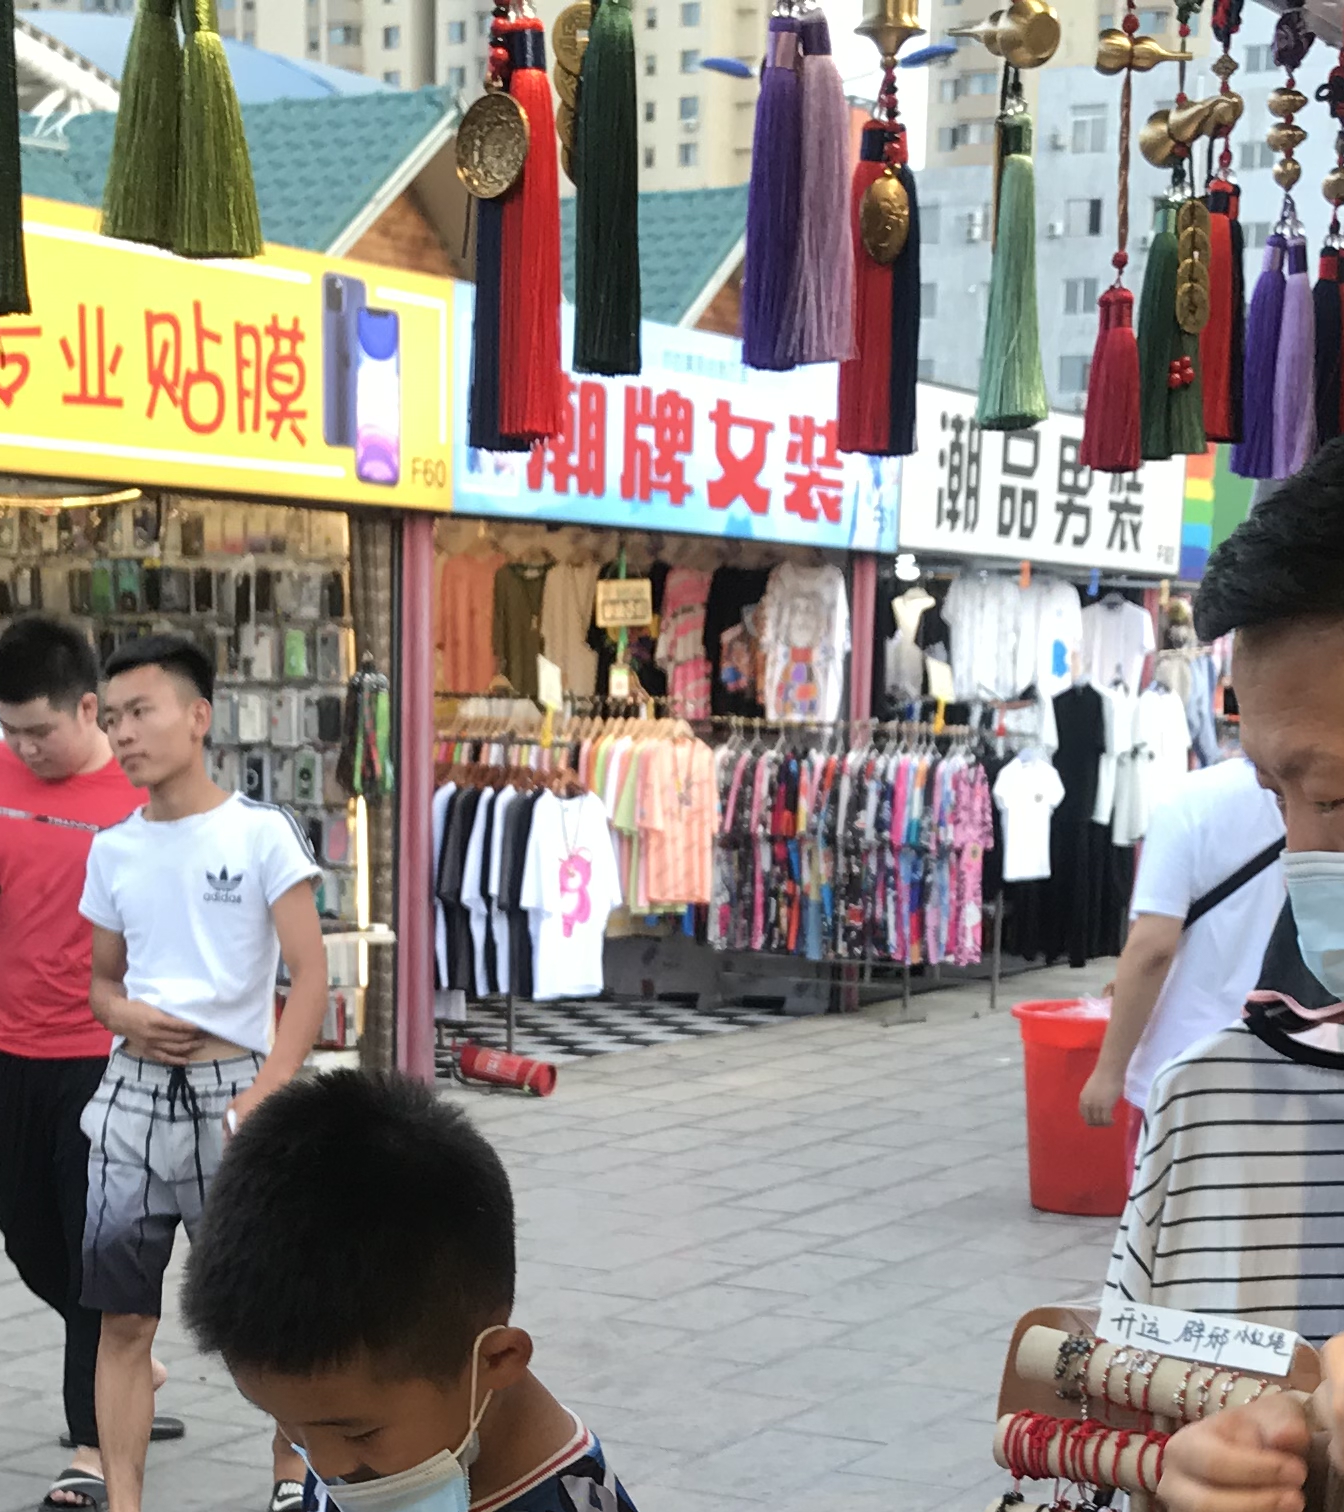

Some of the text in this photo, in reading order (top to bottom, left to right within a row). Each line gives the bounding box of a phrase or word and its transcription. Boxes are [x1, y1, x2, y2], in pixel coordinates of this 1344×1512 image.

[526, 374, 845, 524] 潮牌女装
[411, 456, 447, 489] F60
[935, 410, 1144, 553] 潮品男装
[202, 891, 243, 904] adidas
[277, 1482, 304, 1497] NIK
